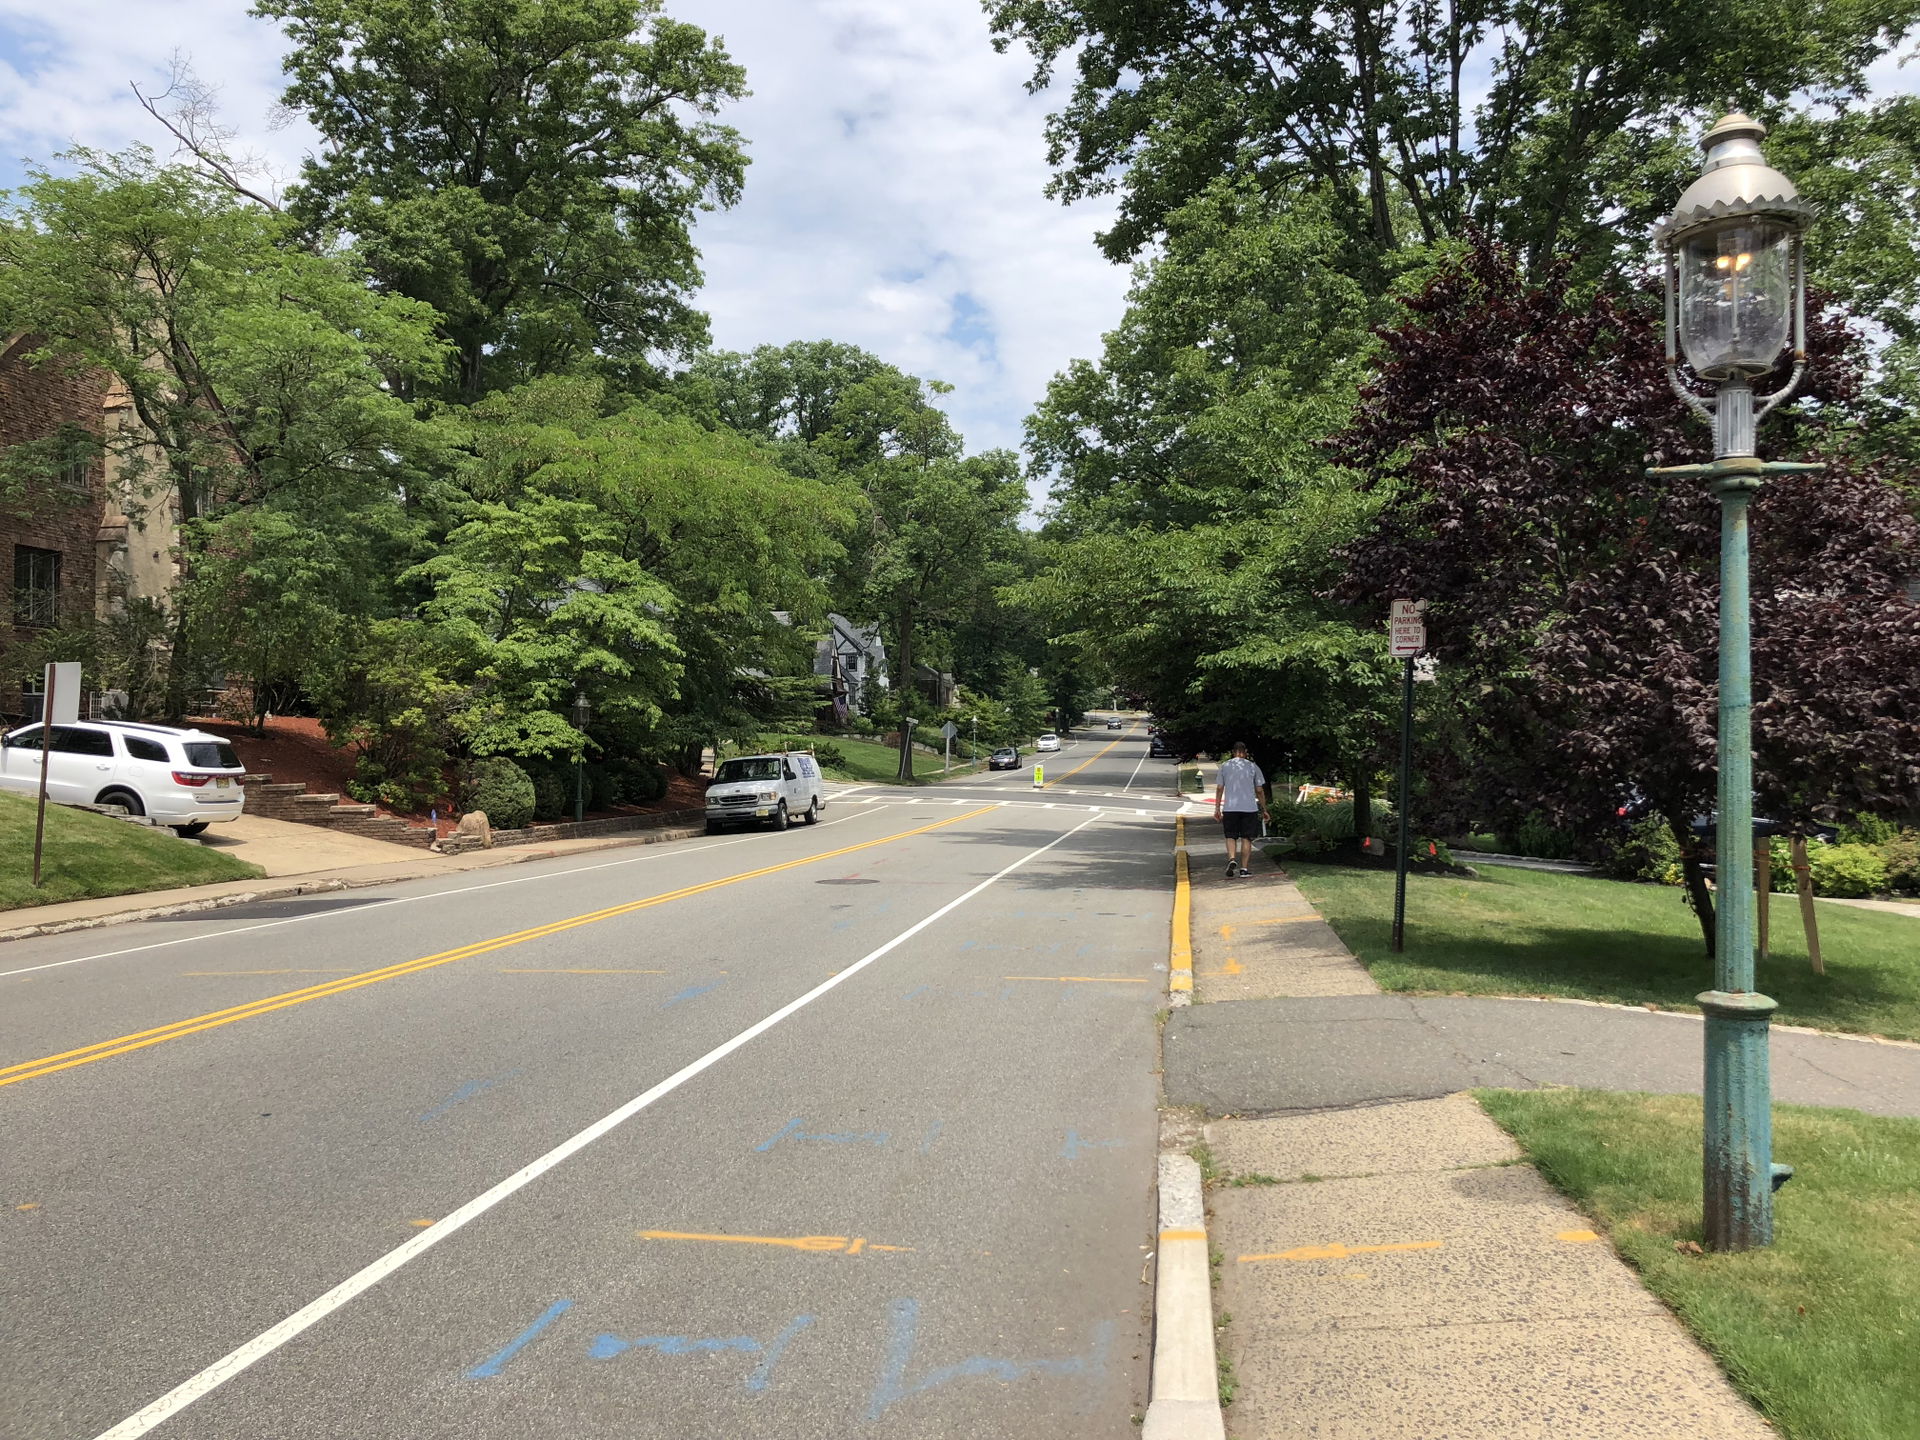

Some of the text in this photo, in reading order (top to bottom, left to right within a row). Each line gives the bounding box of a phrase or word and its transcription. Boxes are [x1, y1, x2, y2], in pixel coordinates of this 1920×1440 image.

[1402, 604, 1416, 614] NO
[1394, 617, 1423, 625] PARKING
[1395, 635, 1420, 643] CORNER
